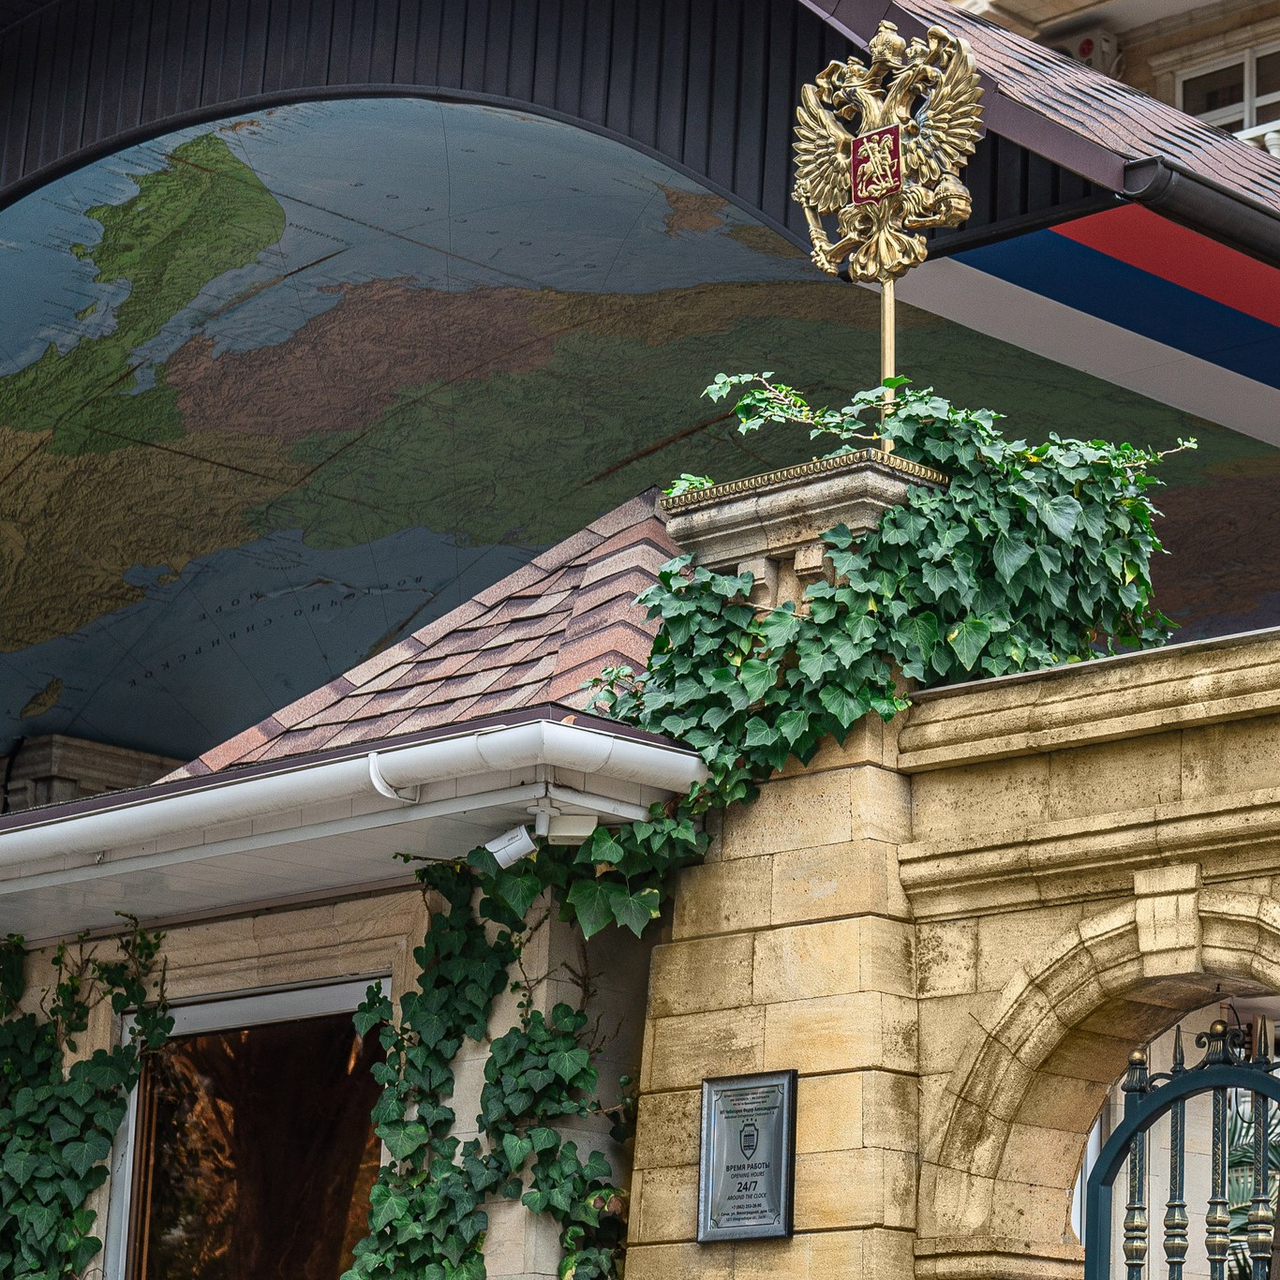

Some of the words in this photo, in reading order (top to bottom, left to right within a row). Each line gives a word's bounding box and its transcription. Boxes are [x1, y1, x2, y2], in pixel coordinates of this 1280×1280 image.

[726, 1164, 745, 1172] ВРЕМЯ
[746, 1162, 770, 1170] РАБОТЫ
[737, 1180, 758, 1192] 24/7
